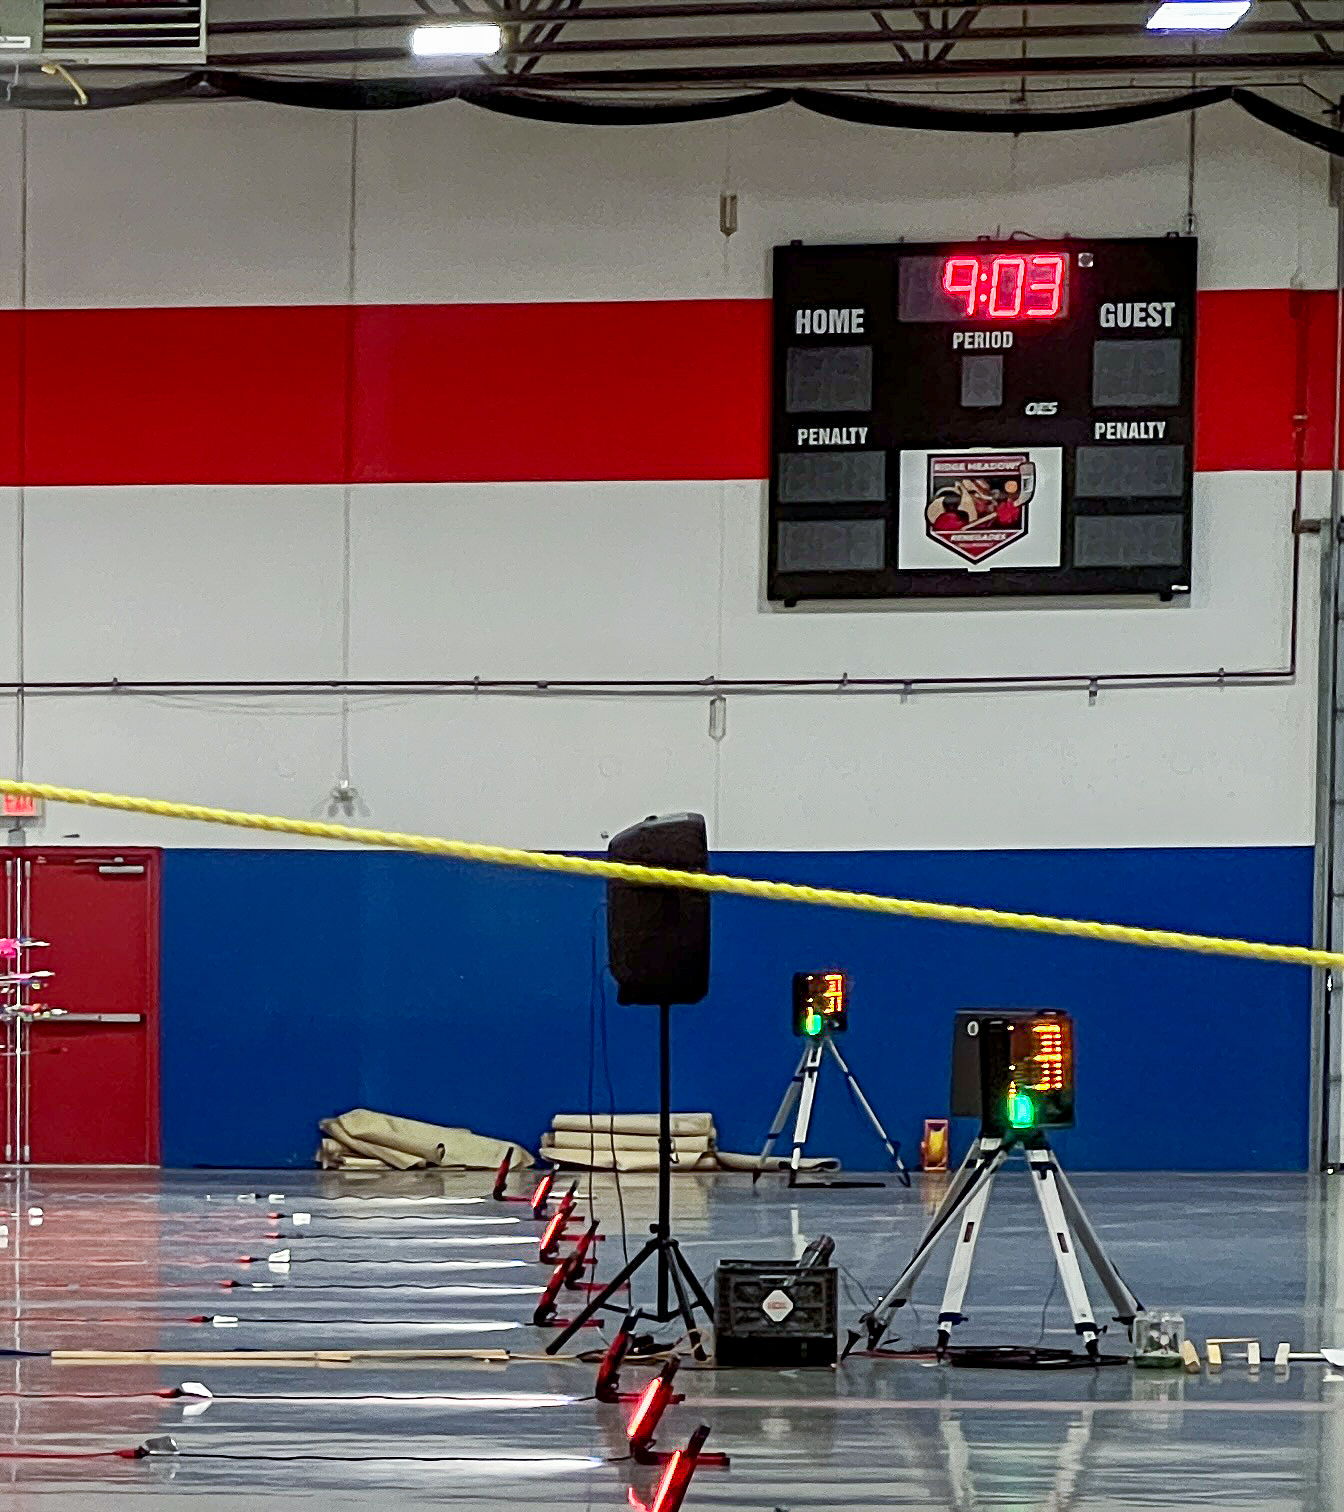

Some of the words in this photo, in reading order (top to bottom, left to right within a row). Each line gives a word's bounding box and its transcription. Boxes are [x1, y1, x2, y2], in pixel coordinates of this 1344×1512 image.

[944, 254, 1065, 319] 9:03
[795, 308, 865, 335] HOME
[1099, 302, 1176, 328] GUEST
[952, 331, 1014, 349] PERIOD
[1024, 401, 1058, 417] OES
[797, 425, 869, 446] PENALTY
[1094, 420, 1166, 441] PENALTY
